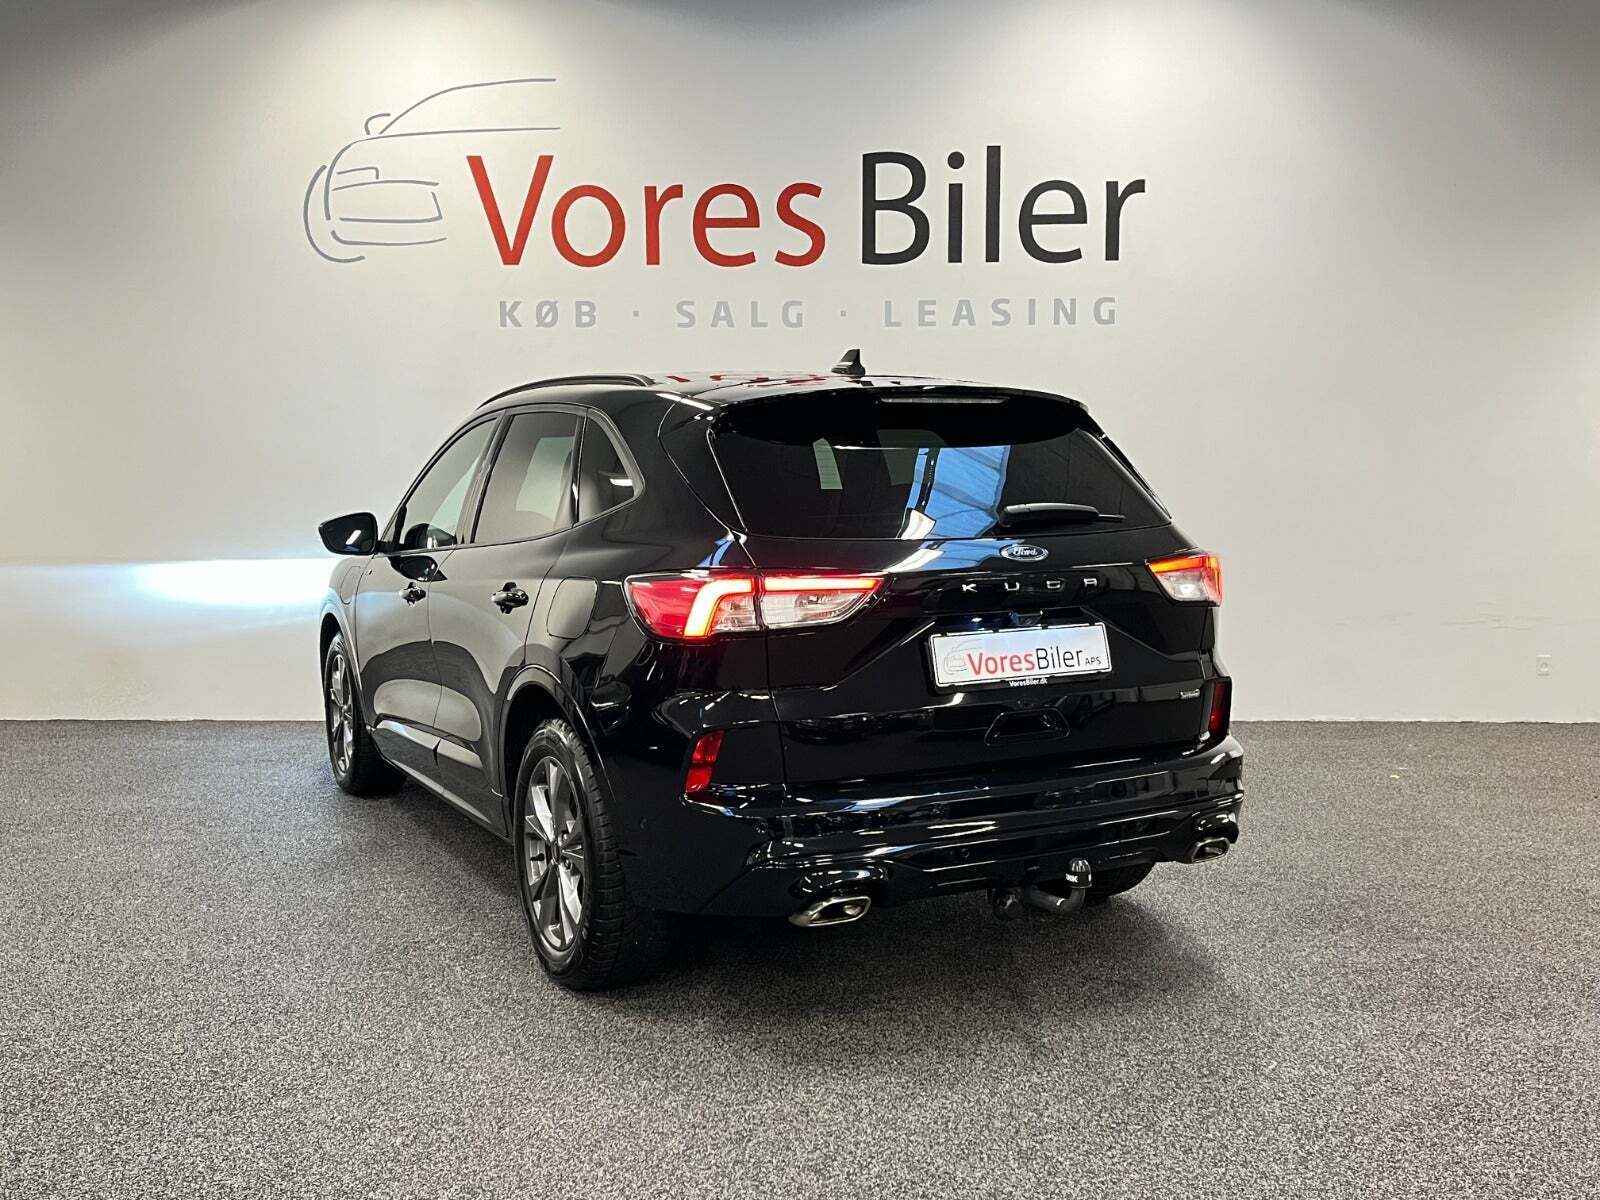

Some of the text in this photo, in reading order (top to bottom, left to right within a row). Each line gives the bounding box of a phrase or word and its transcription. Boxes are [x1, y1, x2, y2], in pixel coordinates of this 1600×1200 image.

[466, 146, 1146, 268] Vores Biler
[500, 297, 1118, 329] KØB SALG LEASING
